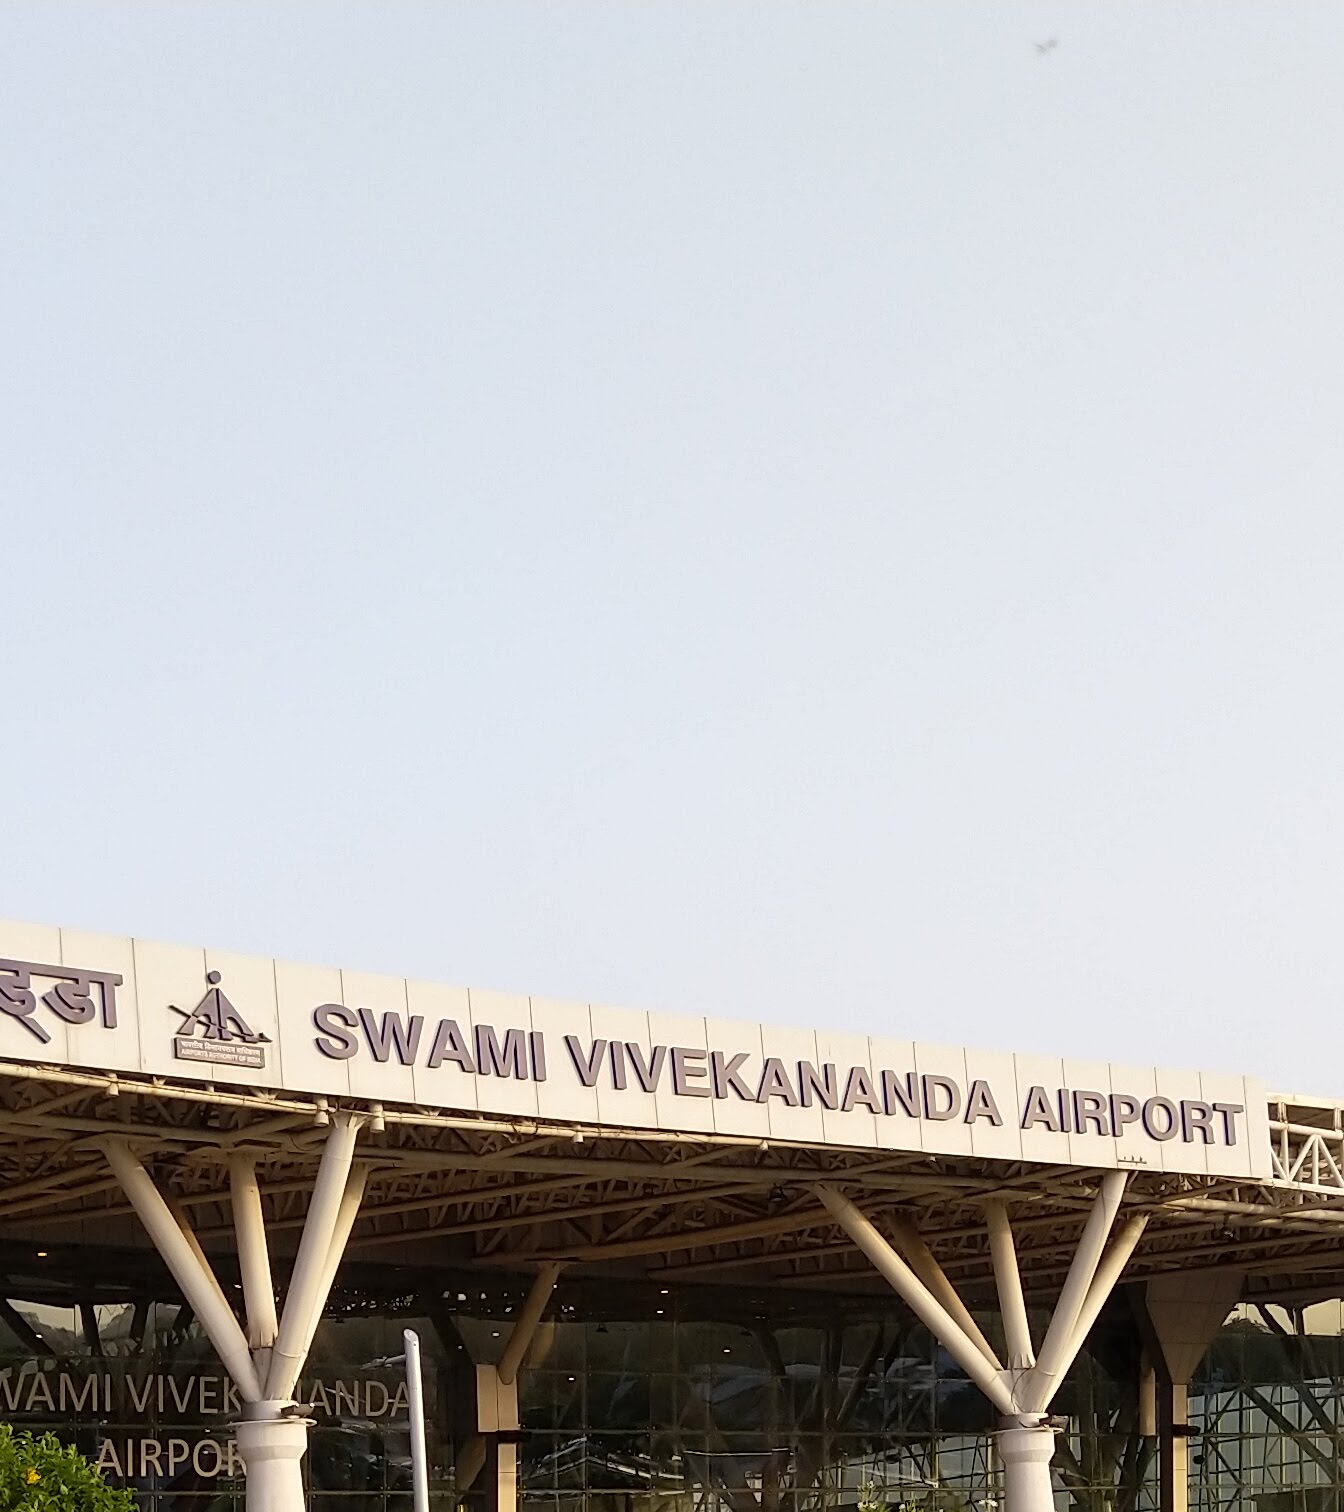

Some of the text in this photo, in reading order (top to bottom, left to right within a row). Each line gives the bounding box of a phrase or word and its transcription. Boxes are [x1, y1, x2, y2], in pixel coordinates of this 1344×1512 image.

[313, 1003, 1244, 1146] SWAMI VIVEKANANDA AIRPORT
[124, 1374, 411, 1418] VIVEKANDA
[96, 1438, 247, 1478] AIRPOR
